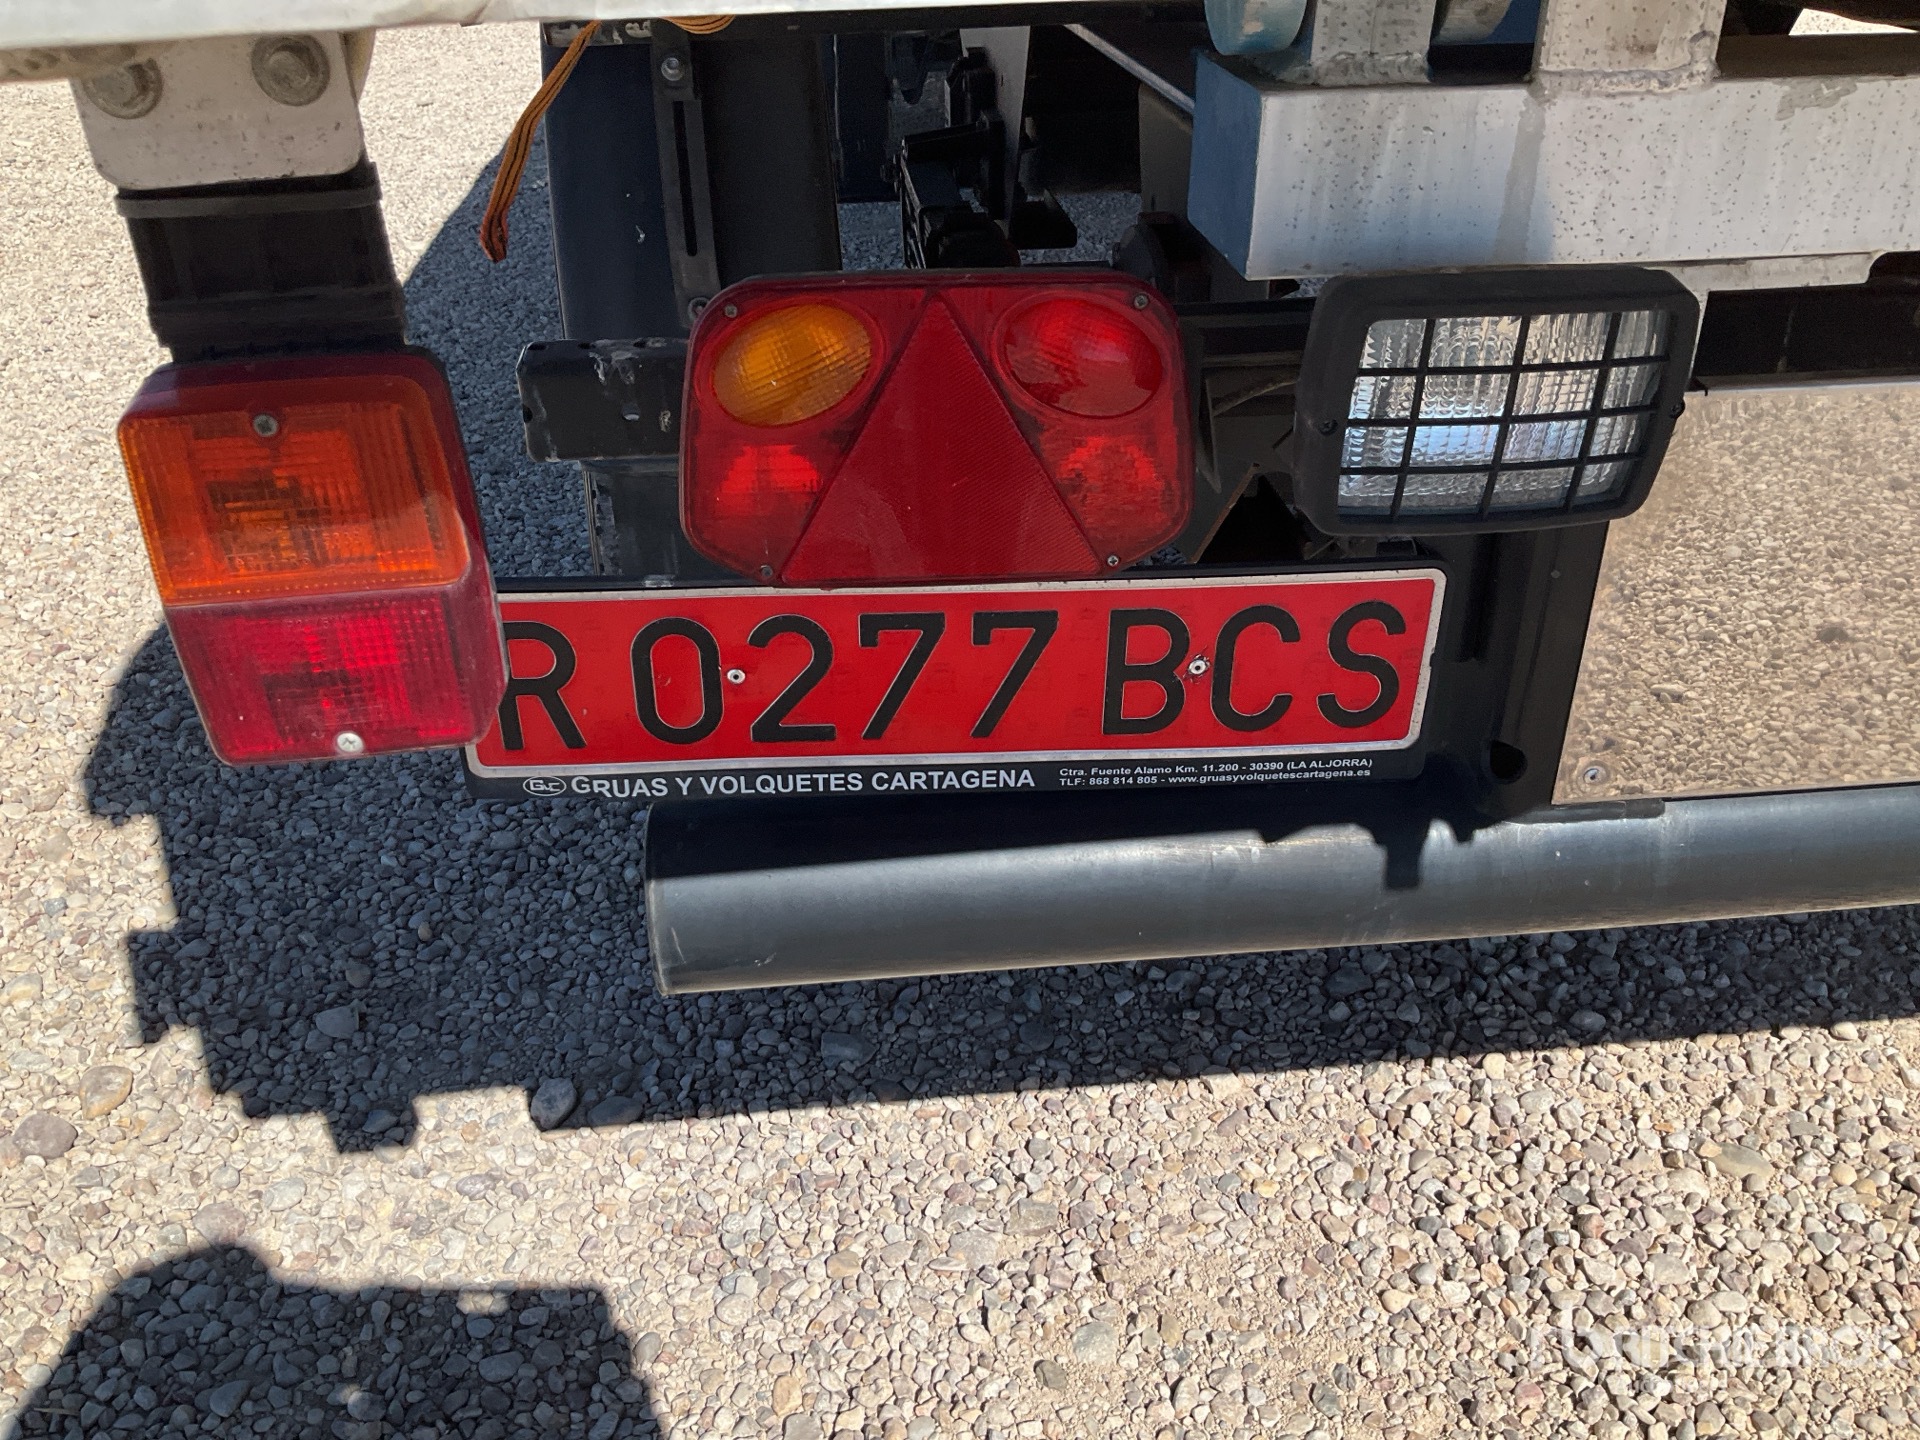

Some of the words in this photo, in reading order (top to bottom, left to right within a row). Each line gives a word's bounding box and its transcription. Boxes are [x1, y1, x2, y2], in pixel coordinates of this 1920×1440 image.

[499, 620, 587, 750] R
[630, 611, 1059, 745] 0277
[1102, 600, 1406, 736] BCS
[1059, 768, 1087, 776] Ctra.
[1091, 766, 1131, 775] Fuente
[1134, 766, 1172, 775] Alamo
[1175, 765, 1198, 773] Km.
[1202, 763, 1239, 772] 11.200
[1249, 761, 1284, 771] 30390
[1287, 760, 1307, 770] (LA
[1309, 758, 1373, 769] ALJORRA)
[1059, 778, 1086, 786] TLF:
[1089, 777, 1110, 785] 868
[1113, 776, 1134, 785] 814
[1137, 775, 1158, 784] 805
[1168, 769, 1371, 783] www.gruasyvolquetescartagena.es
[571, 776, 669, 797] GRUAS
[675, 777, 693, 796] Y
[700, 774, 863, 795] VOLQUETES
[871, 769, 1035, 791] CARTAGENA
